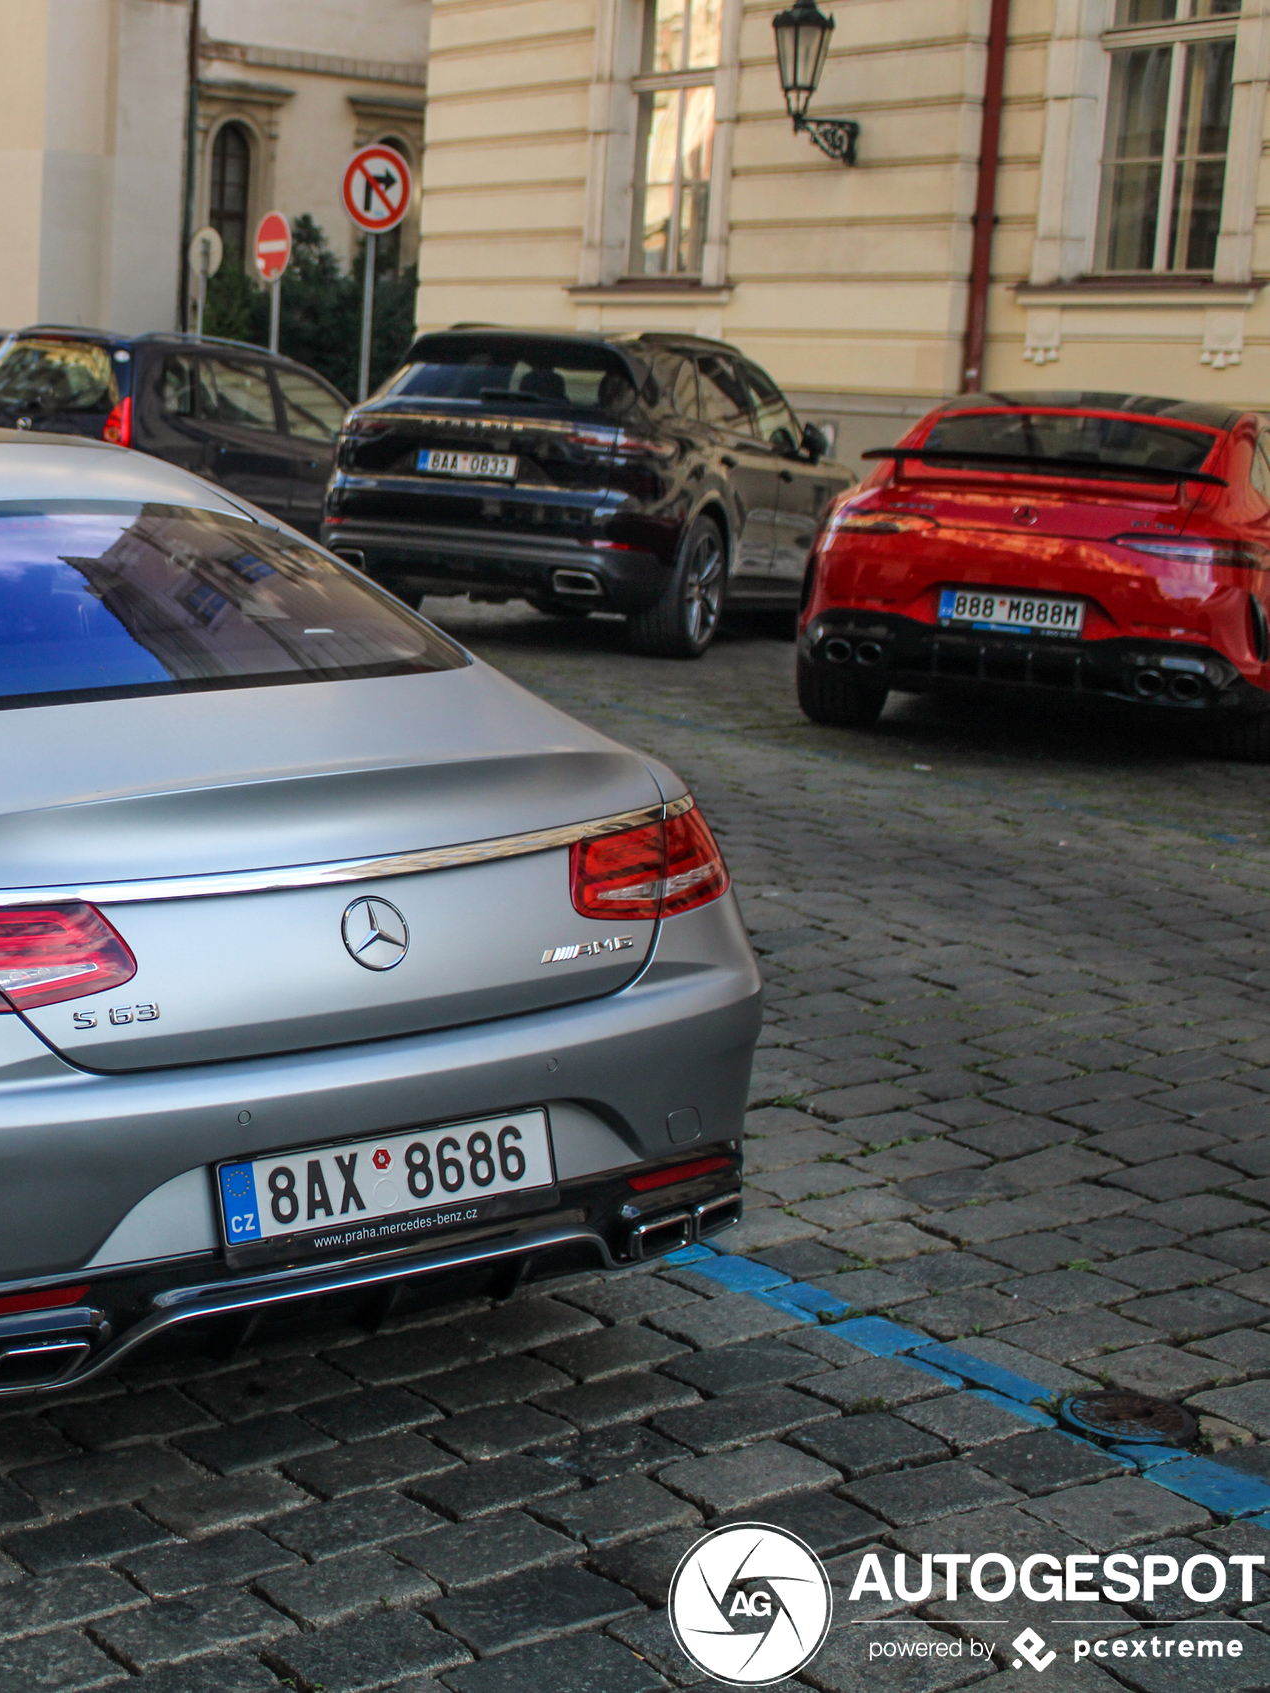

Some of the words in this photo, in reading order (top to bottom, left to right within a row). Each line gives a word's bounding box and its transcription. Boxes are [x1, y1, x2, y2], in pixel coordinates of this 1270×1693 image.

[431, 452, 459, 471] 8AA
[470, 455, 509, 475] 0833
[955, 595, 995, 619] 888
[1007, 600, 1078, 627] M888M
[73, 1009, 98, 1030] S
[109, 1001, 160, 1025] 63
[268, 1152, 367, 1224] 8AX
[404, 1125, 527, 1199] 8686
[231, 1212, 256, 1234] CZ
[314, 1208, 479, 1249] www.praha.mercedes-benz.cz
